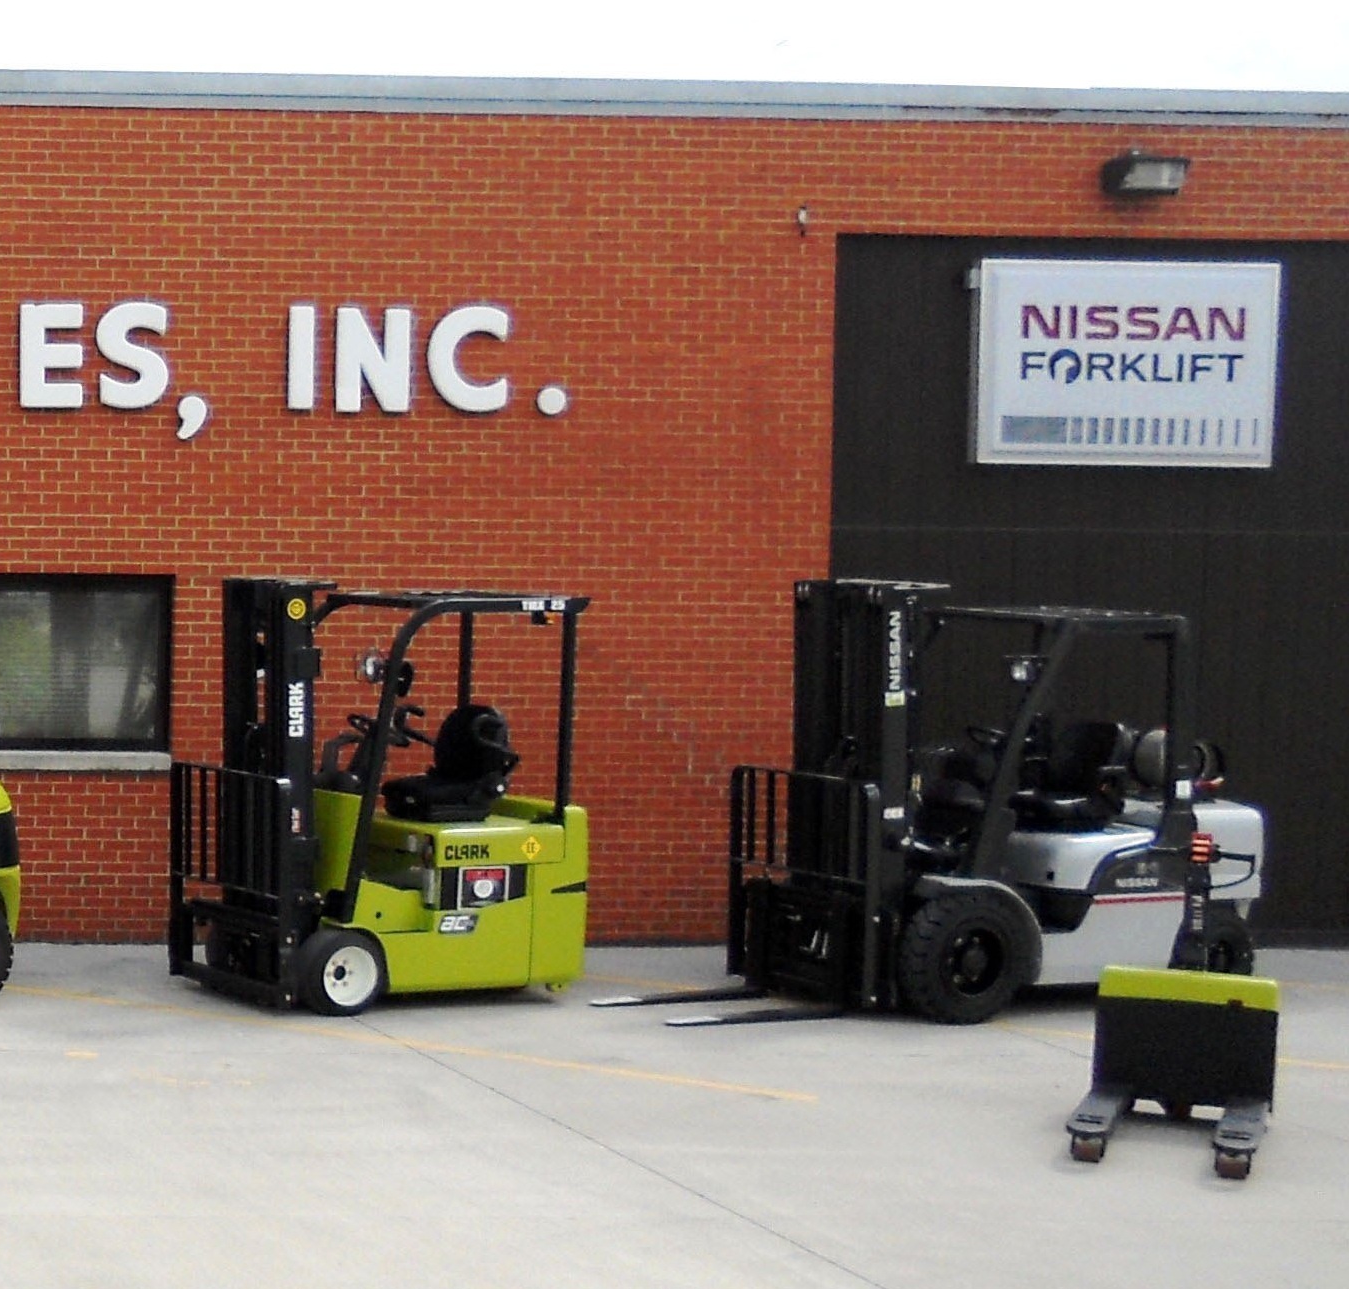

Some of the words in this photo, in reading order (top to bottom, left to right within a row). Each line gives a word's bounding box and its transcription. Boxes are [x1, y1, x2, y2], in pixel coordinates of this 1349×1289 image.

[1020, 305, 1246, 341] NISSAN
[287, 304, 568, 414] INC.
[1020, 348, 1245, 384] FORKLIFT
[888, 610, 902, 691] NISSAN
[287, 680, 304, 738] CLARK
[444, 844, 490, 861] CLARK
